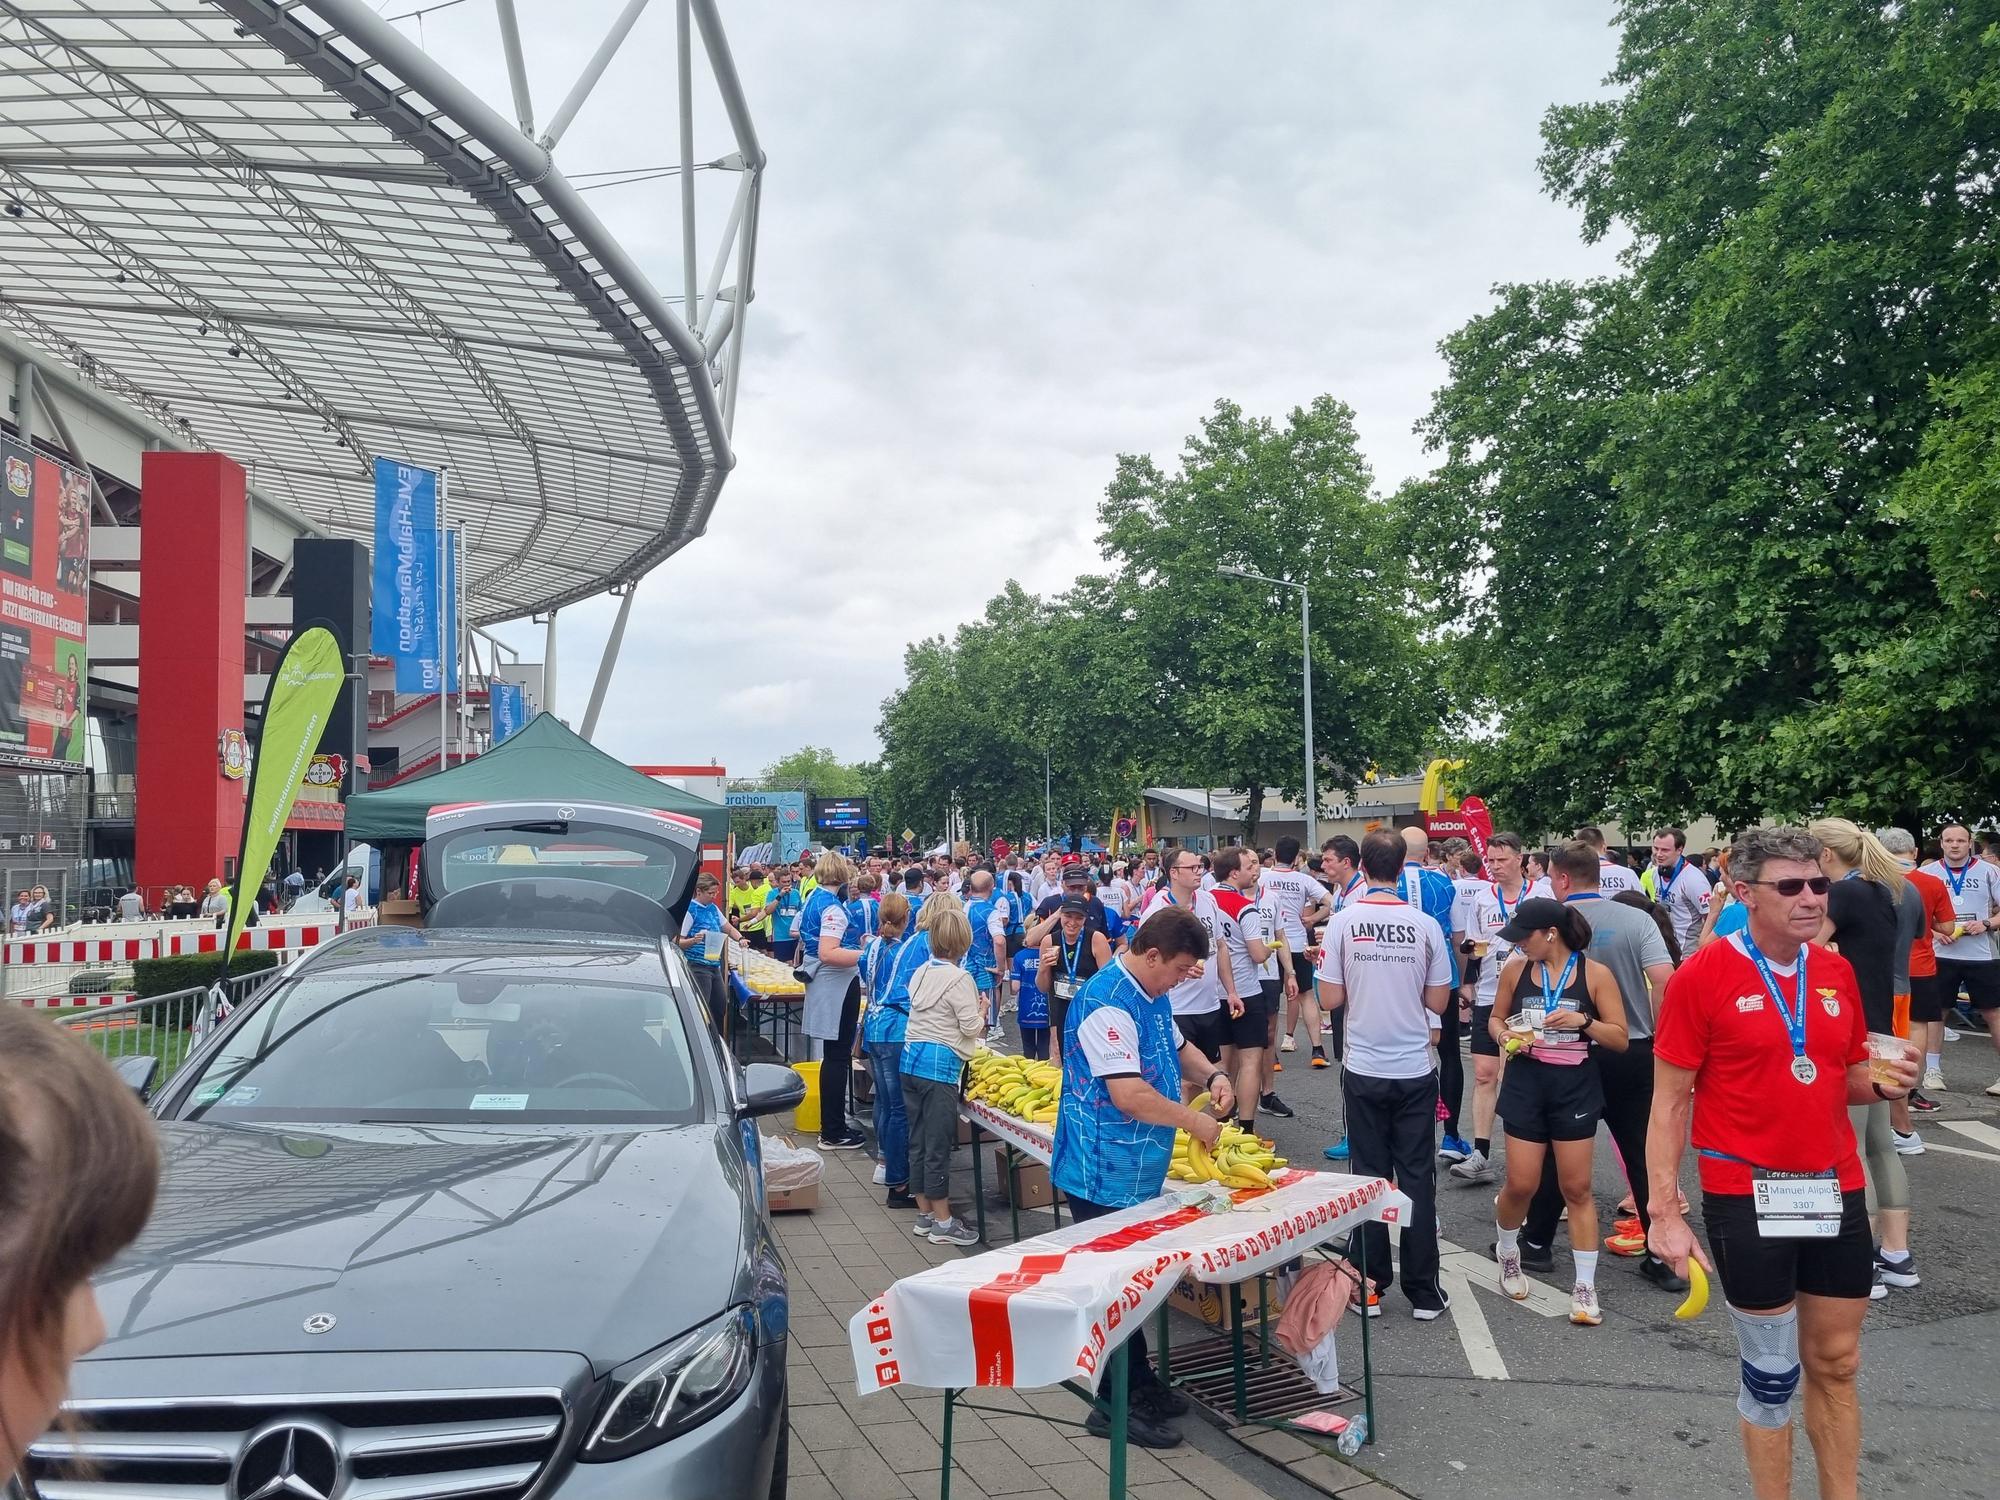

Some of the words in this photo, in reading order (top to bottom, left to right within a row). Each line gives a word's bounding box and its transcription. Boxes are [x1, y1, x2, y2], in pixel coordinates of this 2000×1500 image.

[724, 794, 767, 806] arathon
[1429, 821, 1467, 832] McDon
[1351, 922, 1416, 944] LANXESS
[1353, 951, 1416, 964] Roadrunners
[1769, 1185, 1806, 1195] Manuel
[1792, 1201, 1815, 1209] 3307
